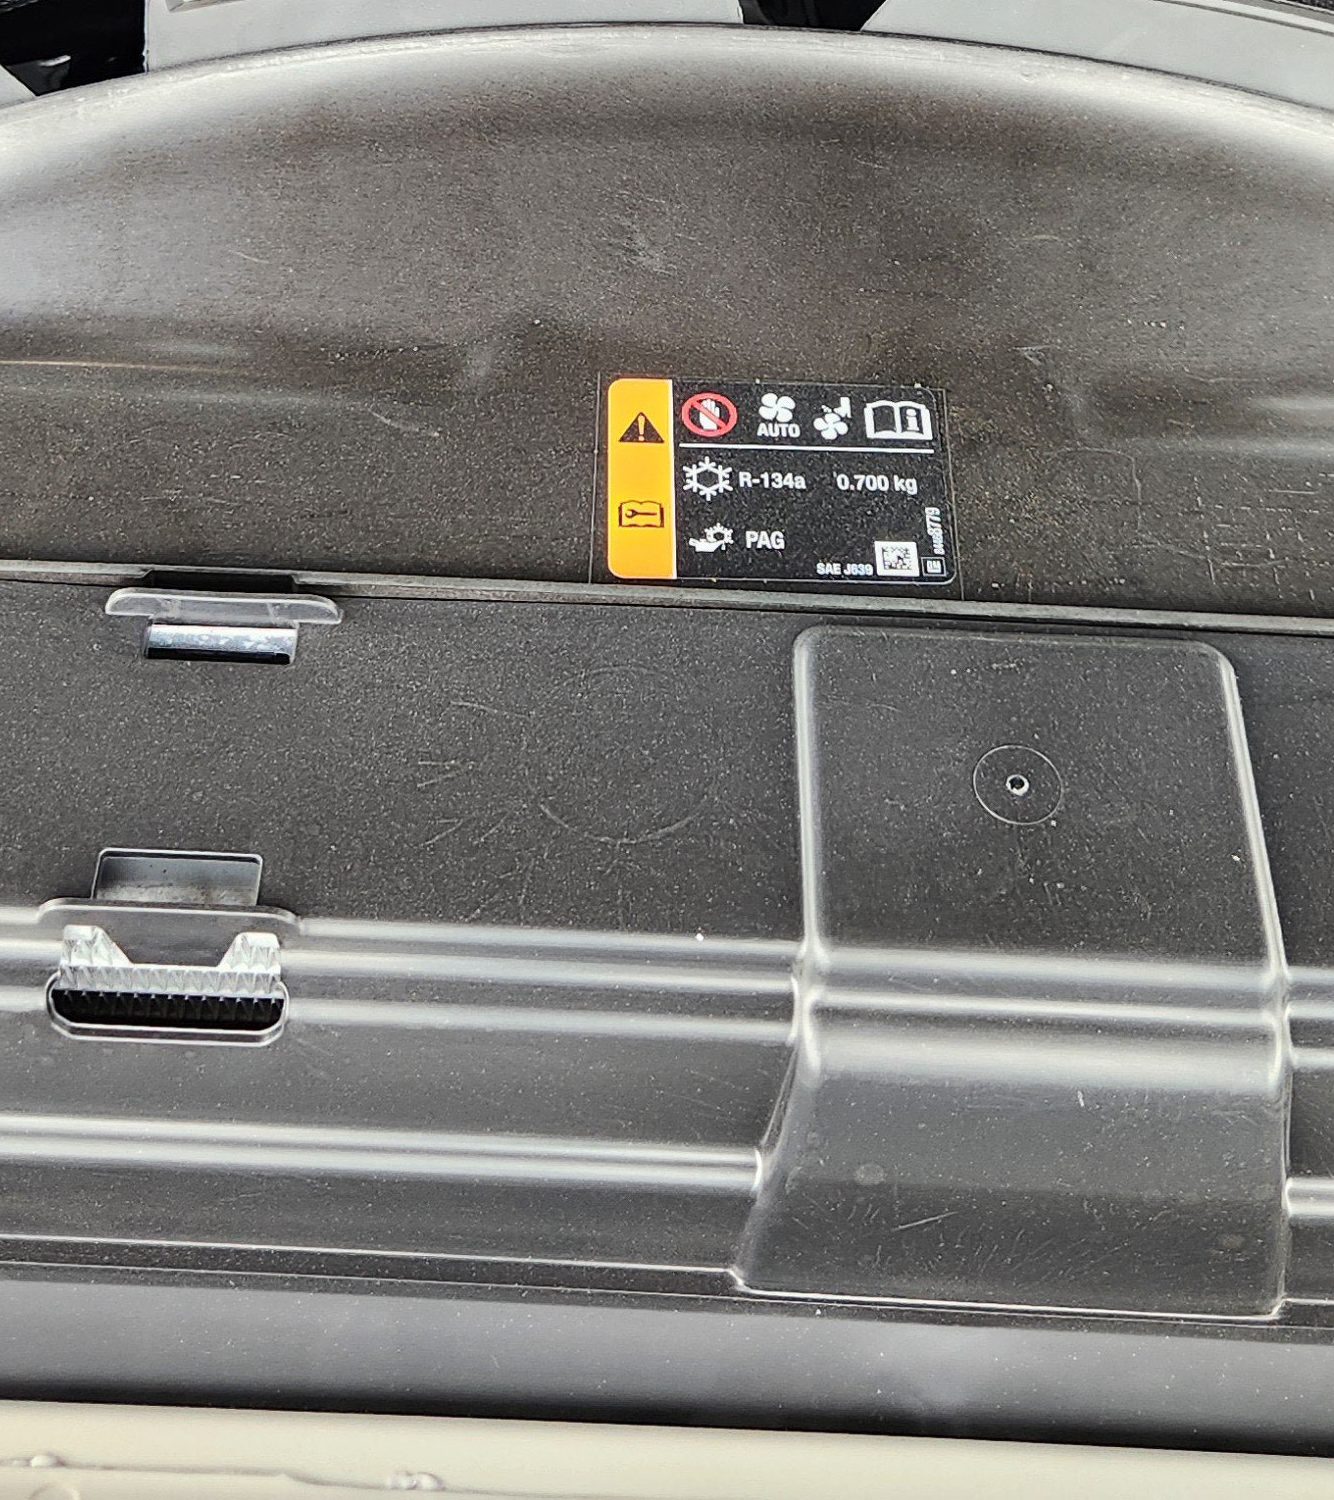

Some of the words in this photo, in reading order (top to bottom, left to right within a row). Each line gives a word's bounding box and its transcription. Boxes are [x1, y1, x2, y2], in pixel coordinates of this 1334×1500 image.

[757, 423, 801, 438] AUTO
[738, 472, 806, 490] R-134a
[837, 473, 889, 492] 0.700
[893, 474, 918, 495] kg
[745, 530, 786, 550] PAG
[816, 562, 842, 576] SAE
[844, 562, 874, 577] J639
